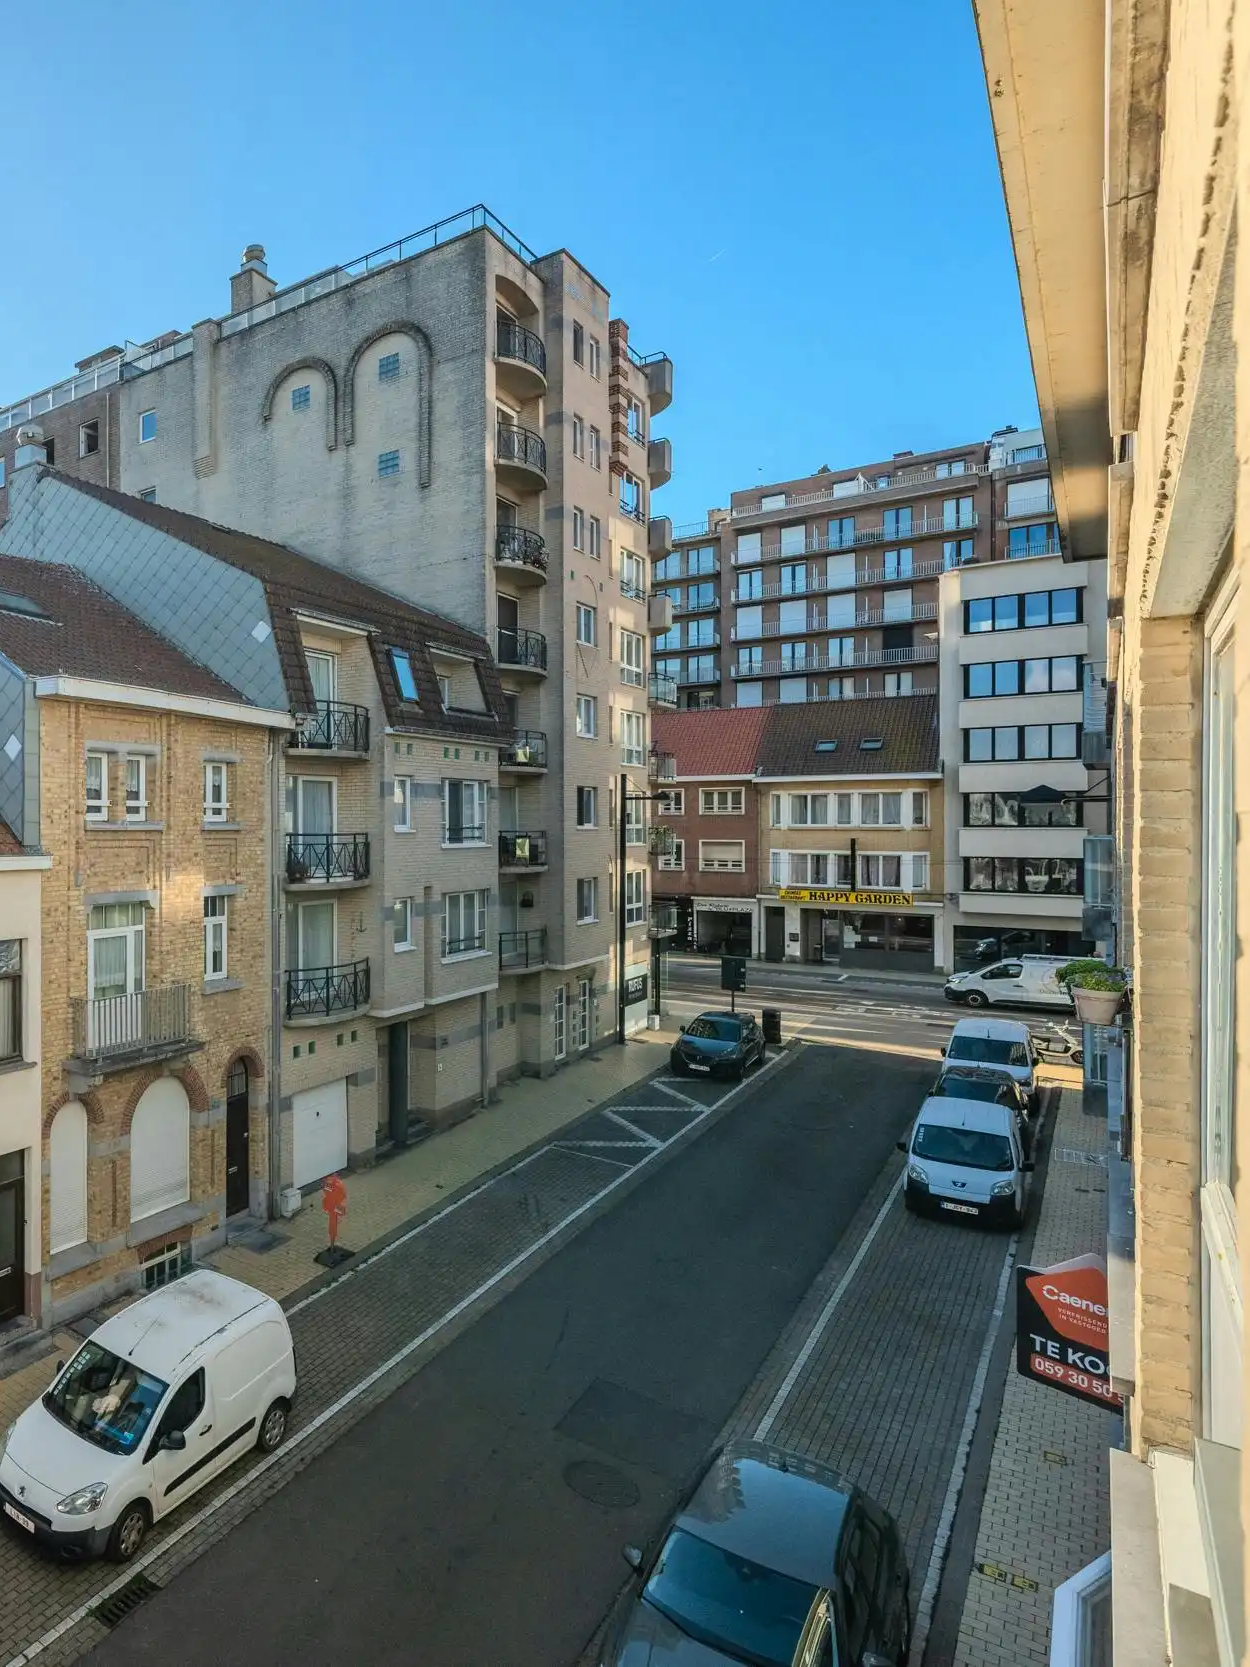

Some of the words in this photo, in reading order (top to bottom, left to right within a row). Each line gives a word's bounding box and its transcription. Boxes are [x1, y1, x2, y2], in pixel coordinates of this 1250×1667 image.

[809, 891, 851, 903] HAPPY
[855, 893, 911, 905] GARDEN
[1042, 1284, 1109, 1317] Caene
[1057, 1307, 1108, 1329] VERFRISSEND
[1069, 1317, 1107, 1334] VASTGOED
[1030, 1333, 1060, 1359] TE
[1067, 1347, 1111, 1376] KO
[1034, 1358, 1063, 1378] 059
[1068, 1370, 1088, 1388] 30
[1092, 1380, 1113, 1398] 50
